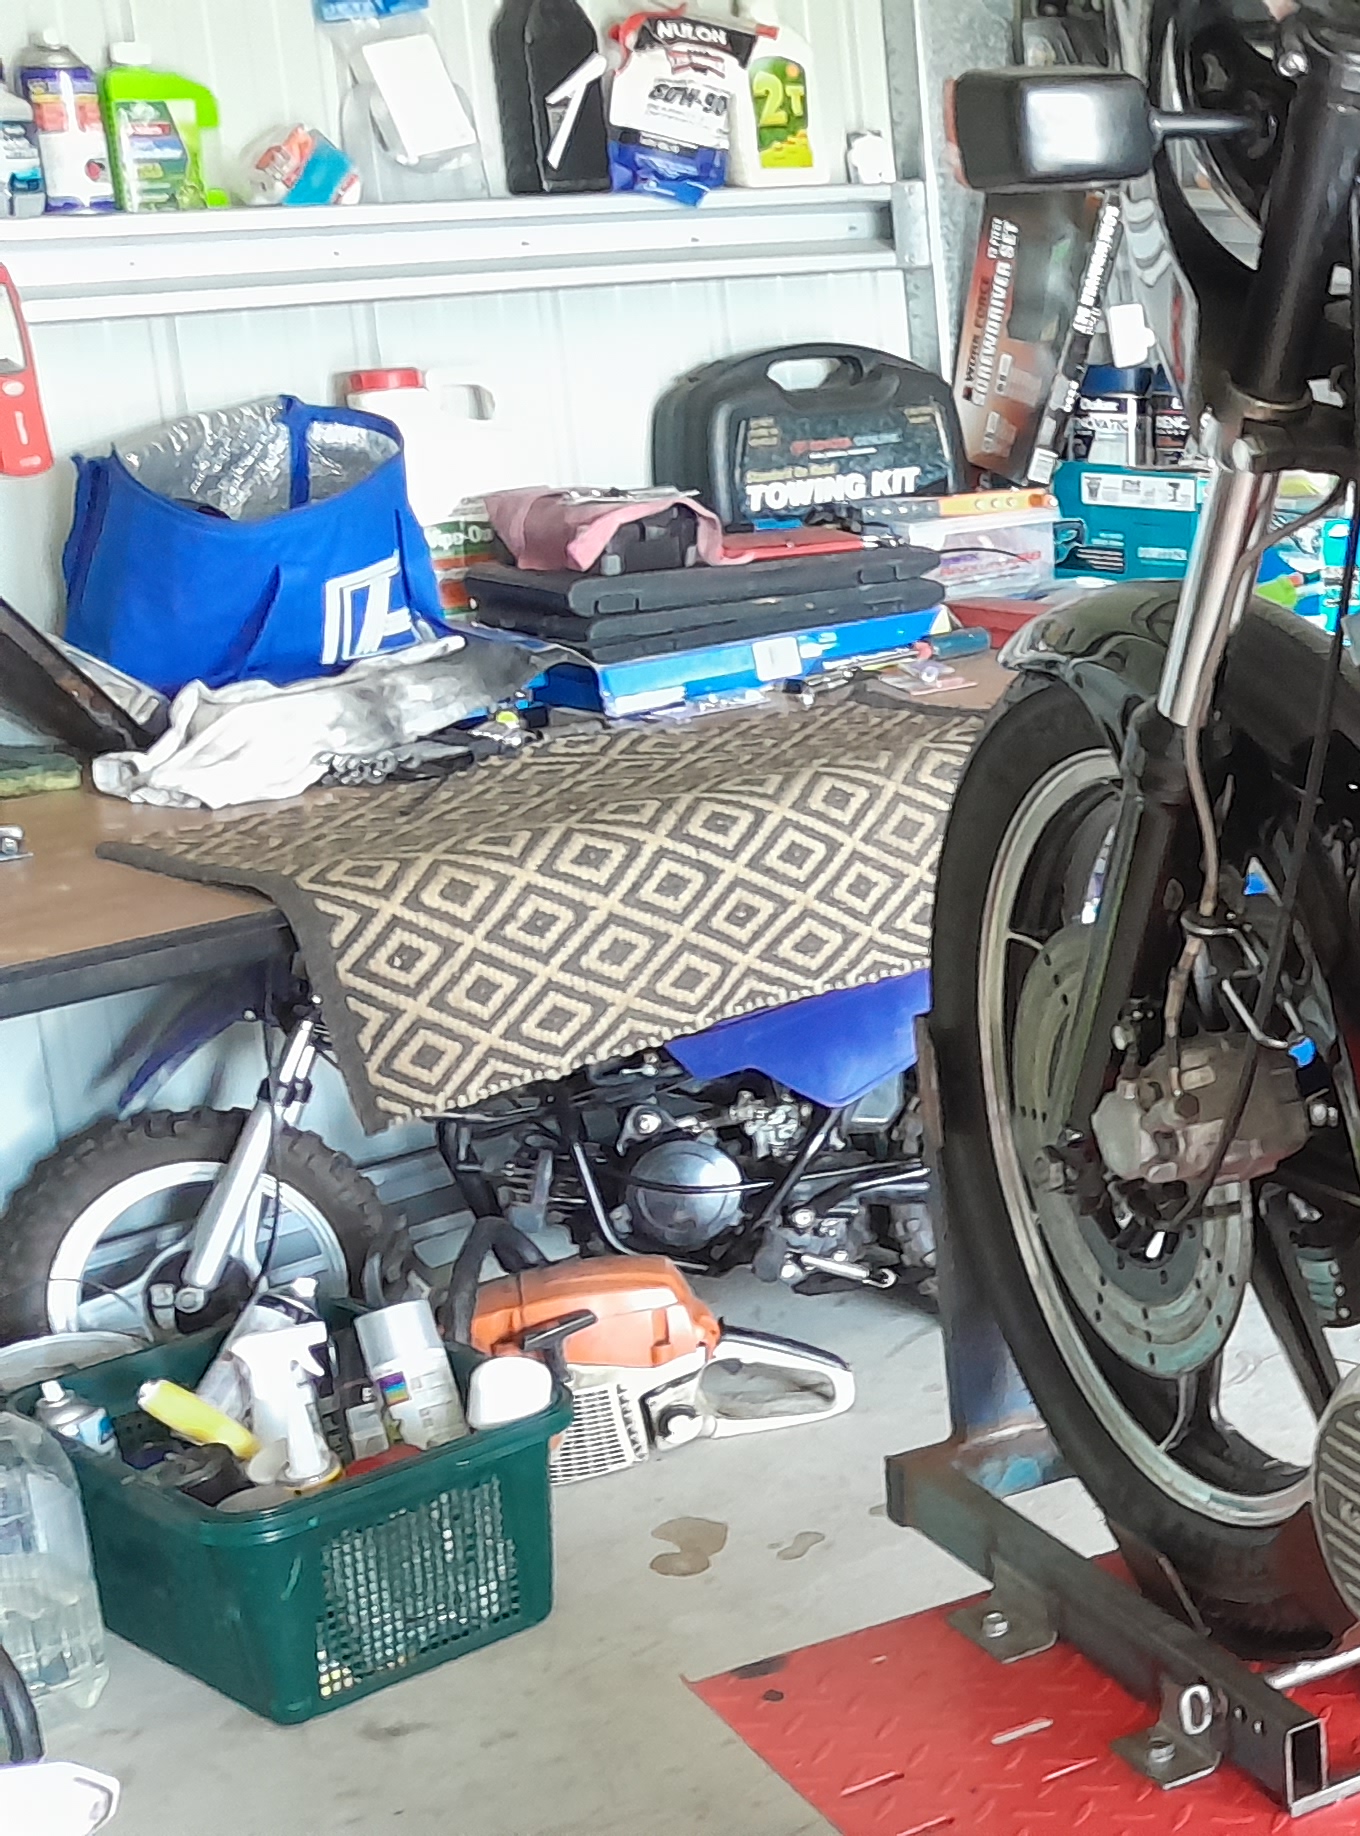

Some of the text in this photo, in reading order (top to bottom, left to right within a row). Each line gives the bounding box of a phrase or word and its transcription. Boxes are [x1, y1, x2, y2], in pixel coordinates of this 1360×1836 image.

[656, 20, 727, 45] NULON
[746, 472, 867, 512] TOWING
[871, 466, 921, 497] KIT
